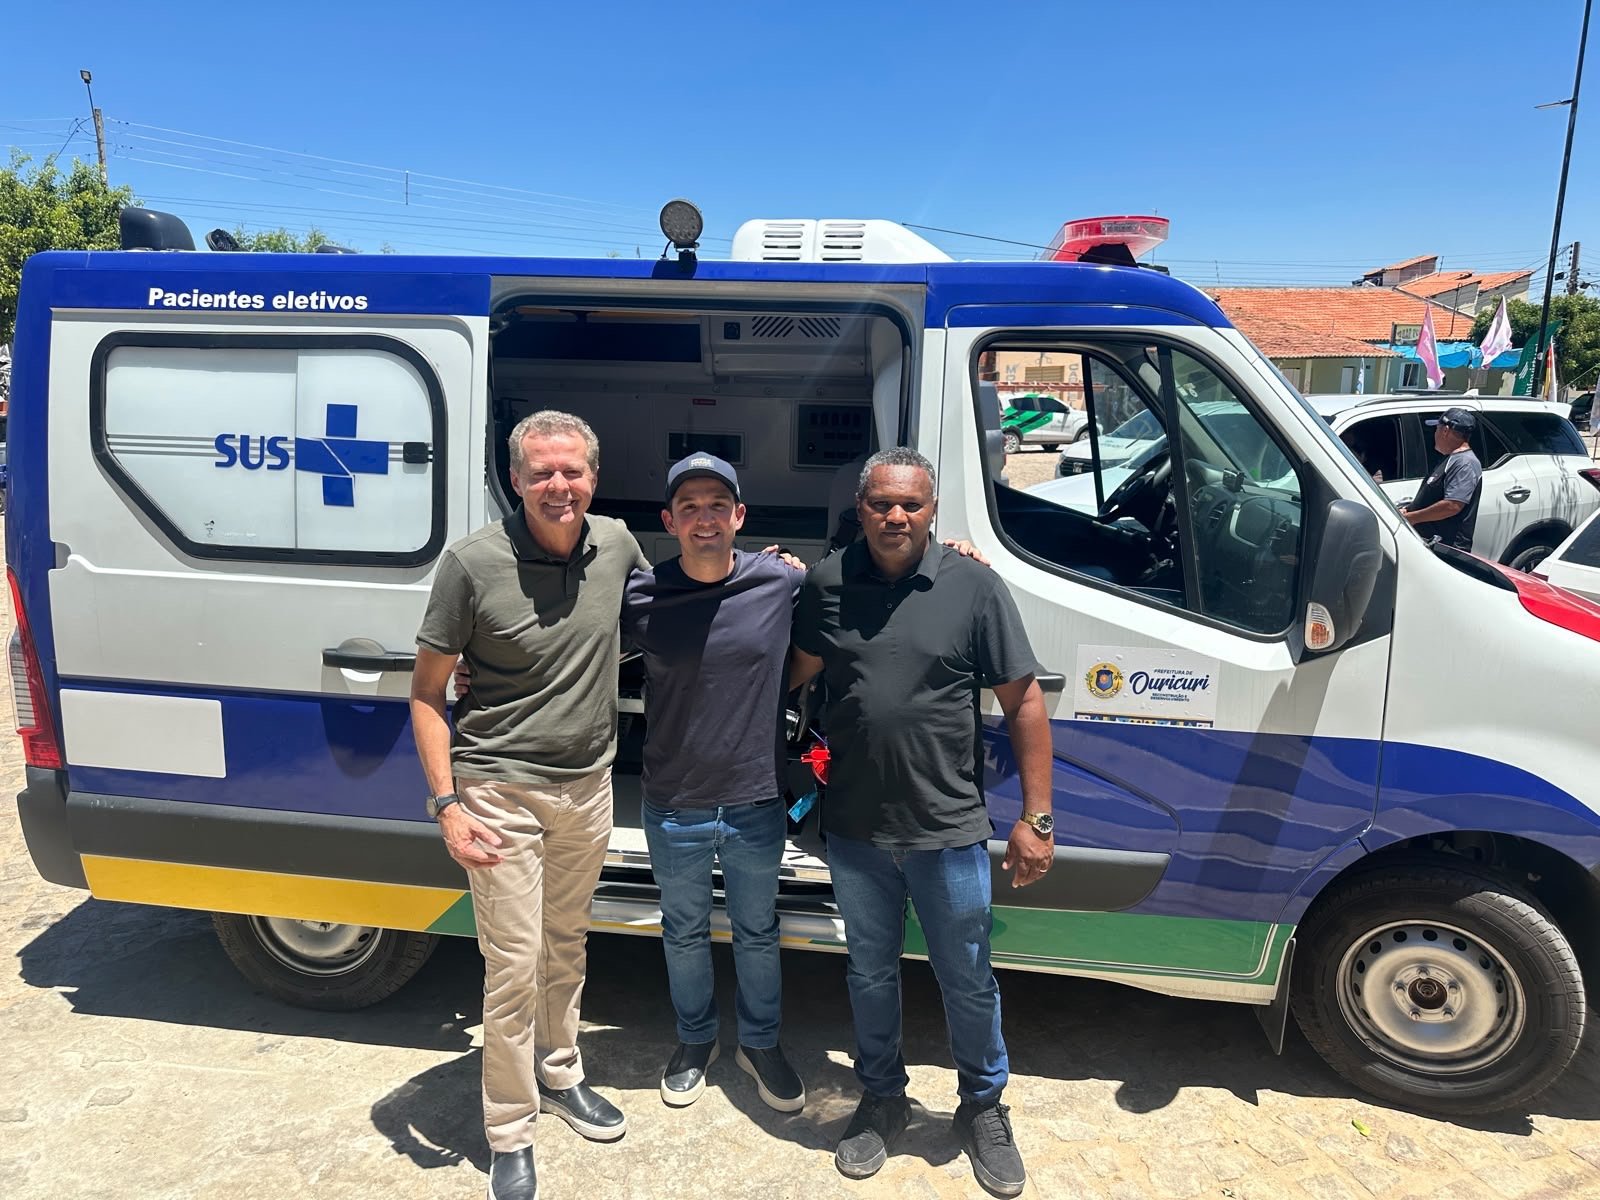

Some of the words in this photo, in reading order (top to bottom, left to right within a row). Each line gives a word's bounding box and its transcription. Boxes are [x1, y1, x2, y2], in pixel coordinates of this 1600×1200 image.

[148, 287, 265, 309] Pacientes
[272, 291, 368, 310] eletivos
[214, 433, 290, 470] SUS
[1129, 671, 1209, 694] Ouricuri
